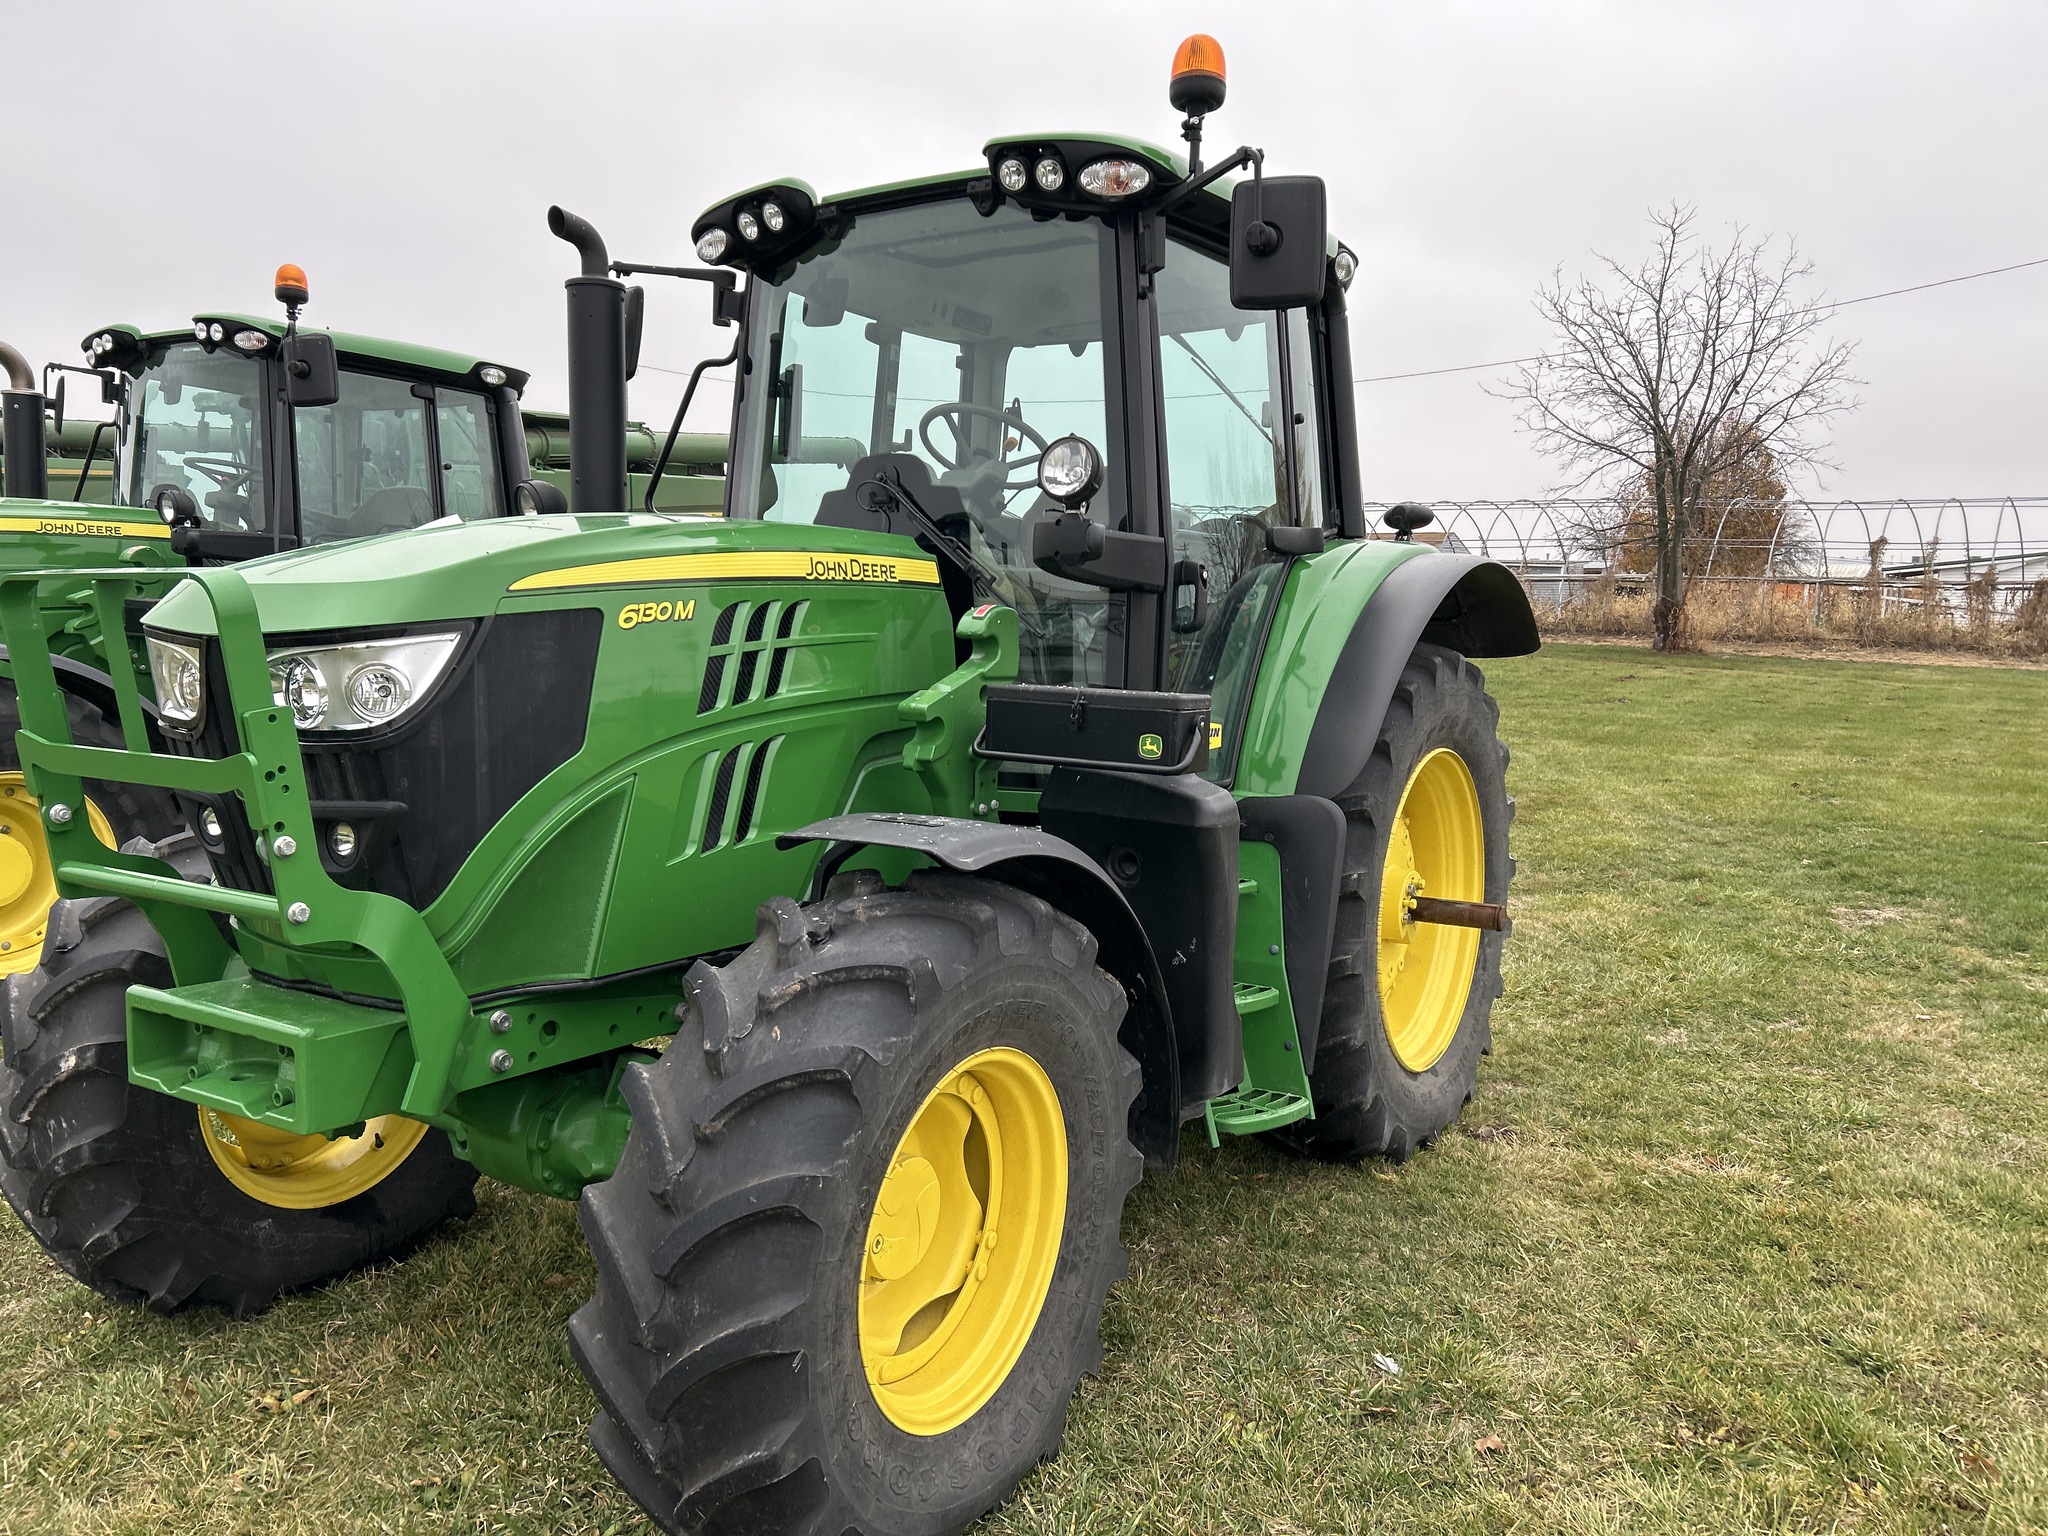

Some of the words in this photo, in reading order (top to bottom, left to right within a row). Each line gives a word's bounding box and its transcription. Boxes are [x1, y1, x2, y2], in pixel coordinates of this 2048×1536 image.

[35, 520, 74, 534] JOHN
[76, 522, 122, 535] DEERE
[805, 556, 848, 578] JOHN
[850, 558, 897, 581] DEERE
